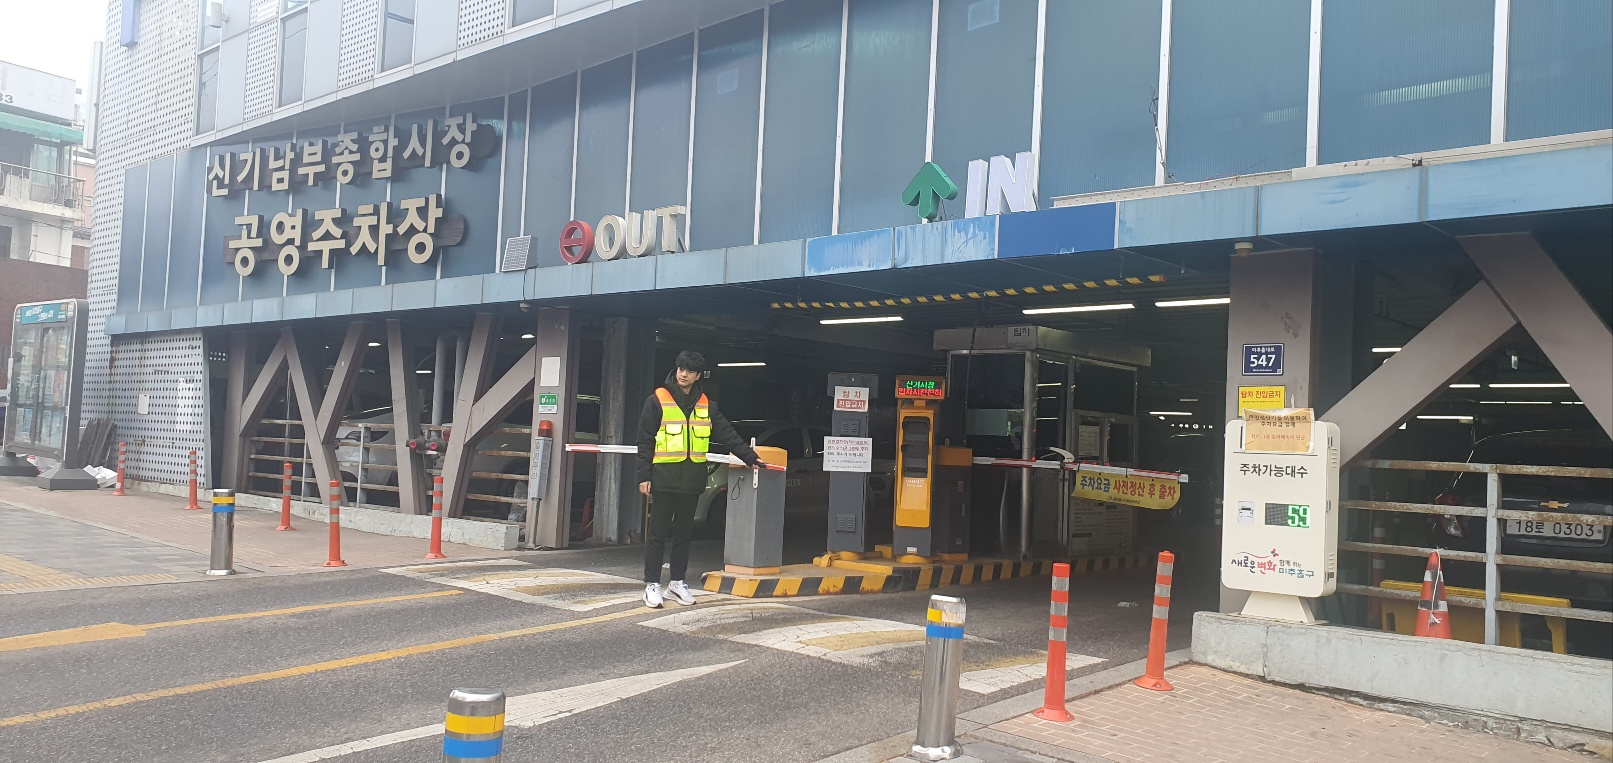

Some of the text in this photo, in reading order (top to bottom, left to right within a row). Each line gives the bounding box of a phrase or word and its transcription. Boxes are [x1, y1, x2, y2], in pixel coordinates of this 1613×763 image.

[208, 112, 479, 197] 신기남부종합시장
[964, 151, 1036, 219] IN
[228, 193, 444, 276] 공영주차장
[594, 204, 687, 261] OUT
[1013, 327, 1031, 337] 탑차
[1249, 354, 1276, 367] 547
[906, 380, 936, 389] 신기시장
[1255, 390, 1281, 399] 진입금지
[1239, 463, 1309, 479] 주차가능대수
[1080, 475, 1111, 493] 주차요금
[1112, 479, 1146, 498] 사전정산
[1147, 483, 1156, 499] 후
[1158, 483, 1177, 501] 출차
[1287, 504, 1311, 528] 59
[1515, 520, 1595, 537] 18로 0303
[1230, 555, 1277, 575] 새로운 변화
[1278, 567, 1315, 579] 미추홀구
